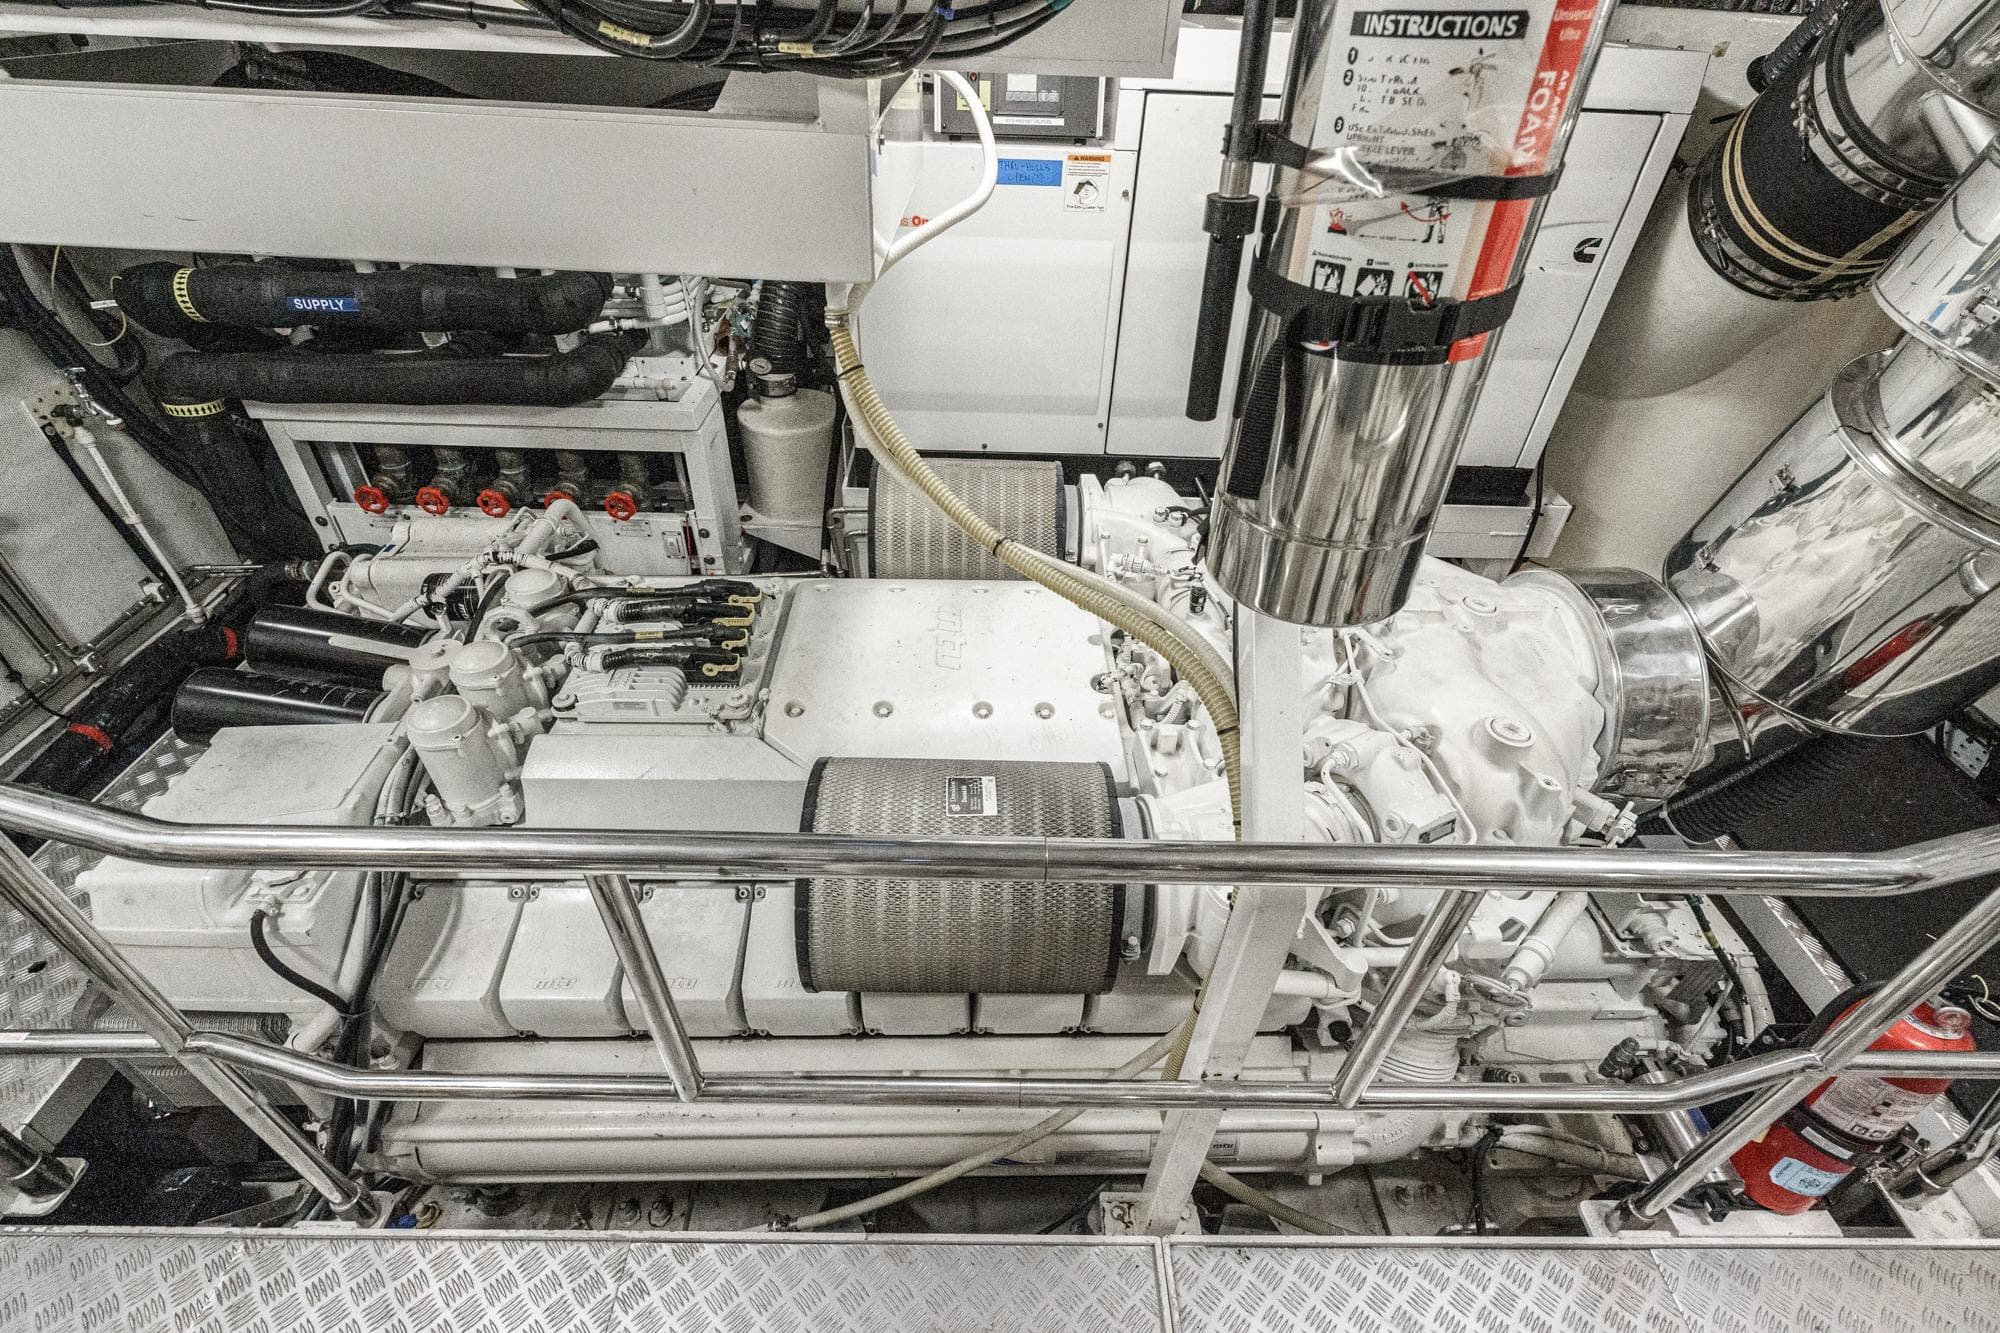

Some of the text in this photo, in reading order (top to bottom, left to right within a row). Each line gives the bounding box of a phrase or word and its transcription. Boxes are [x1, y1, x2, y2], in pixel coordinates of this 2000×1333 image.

[1363, 13, 1520, 37] INSTRUCTIONS
[1512, 70, 1556, 167] FOAM
[293, 298, 344, 310] SUPPLY
